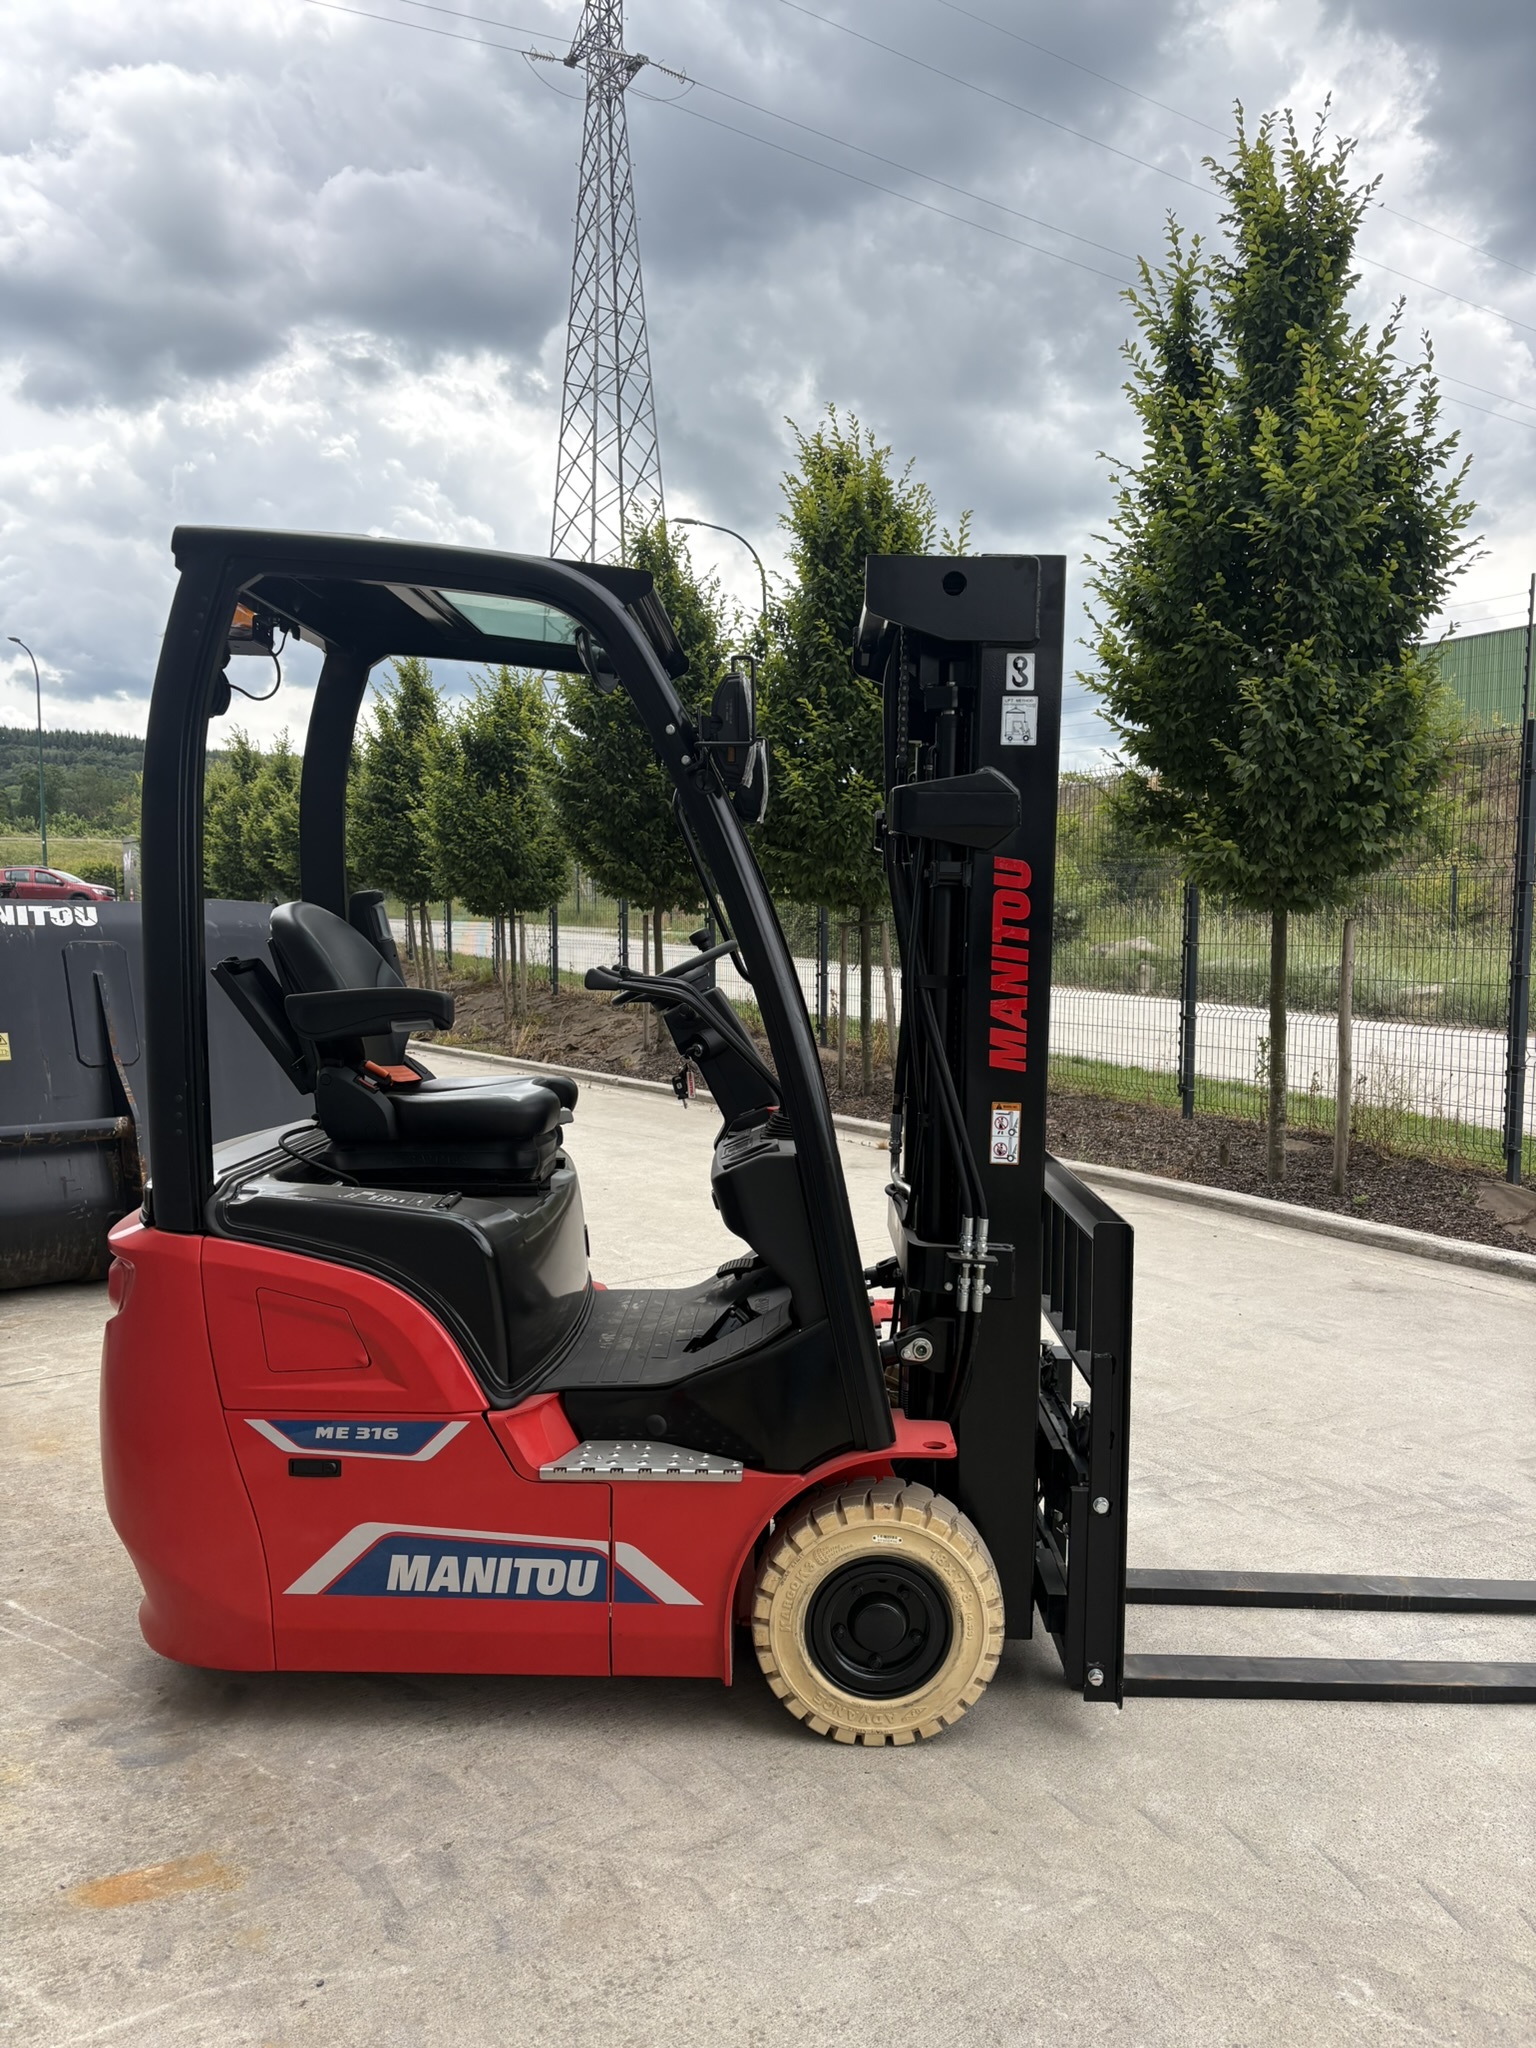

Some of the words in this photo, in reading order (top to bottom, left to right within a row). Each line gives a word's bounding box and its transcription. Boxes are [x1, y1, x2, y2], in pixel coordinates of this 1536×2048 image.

[988, 856, 1032, 1073] MANITOU
[315, 1427, 350, 1439] ME
[355, 1427, 399, 1440] 316
[386, 1554, 599, 1597] MANITOU
[812, 1691, 897, 1725] ADVANCE
